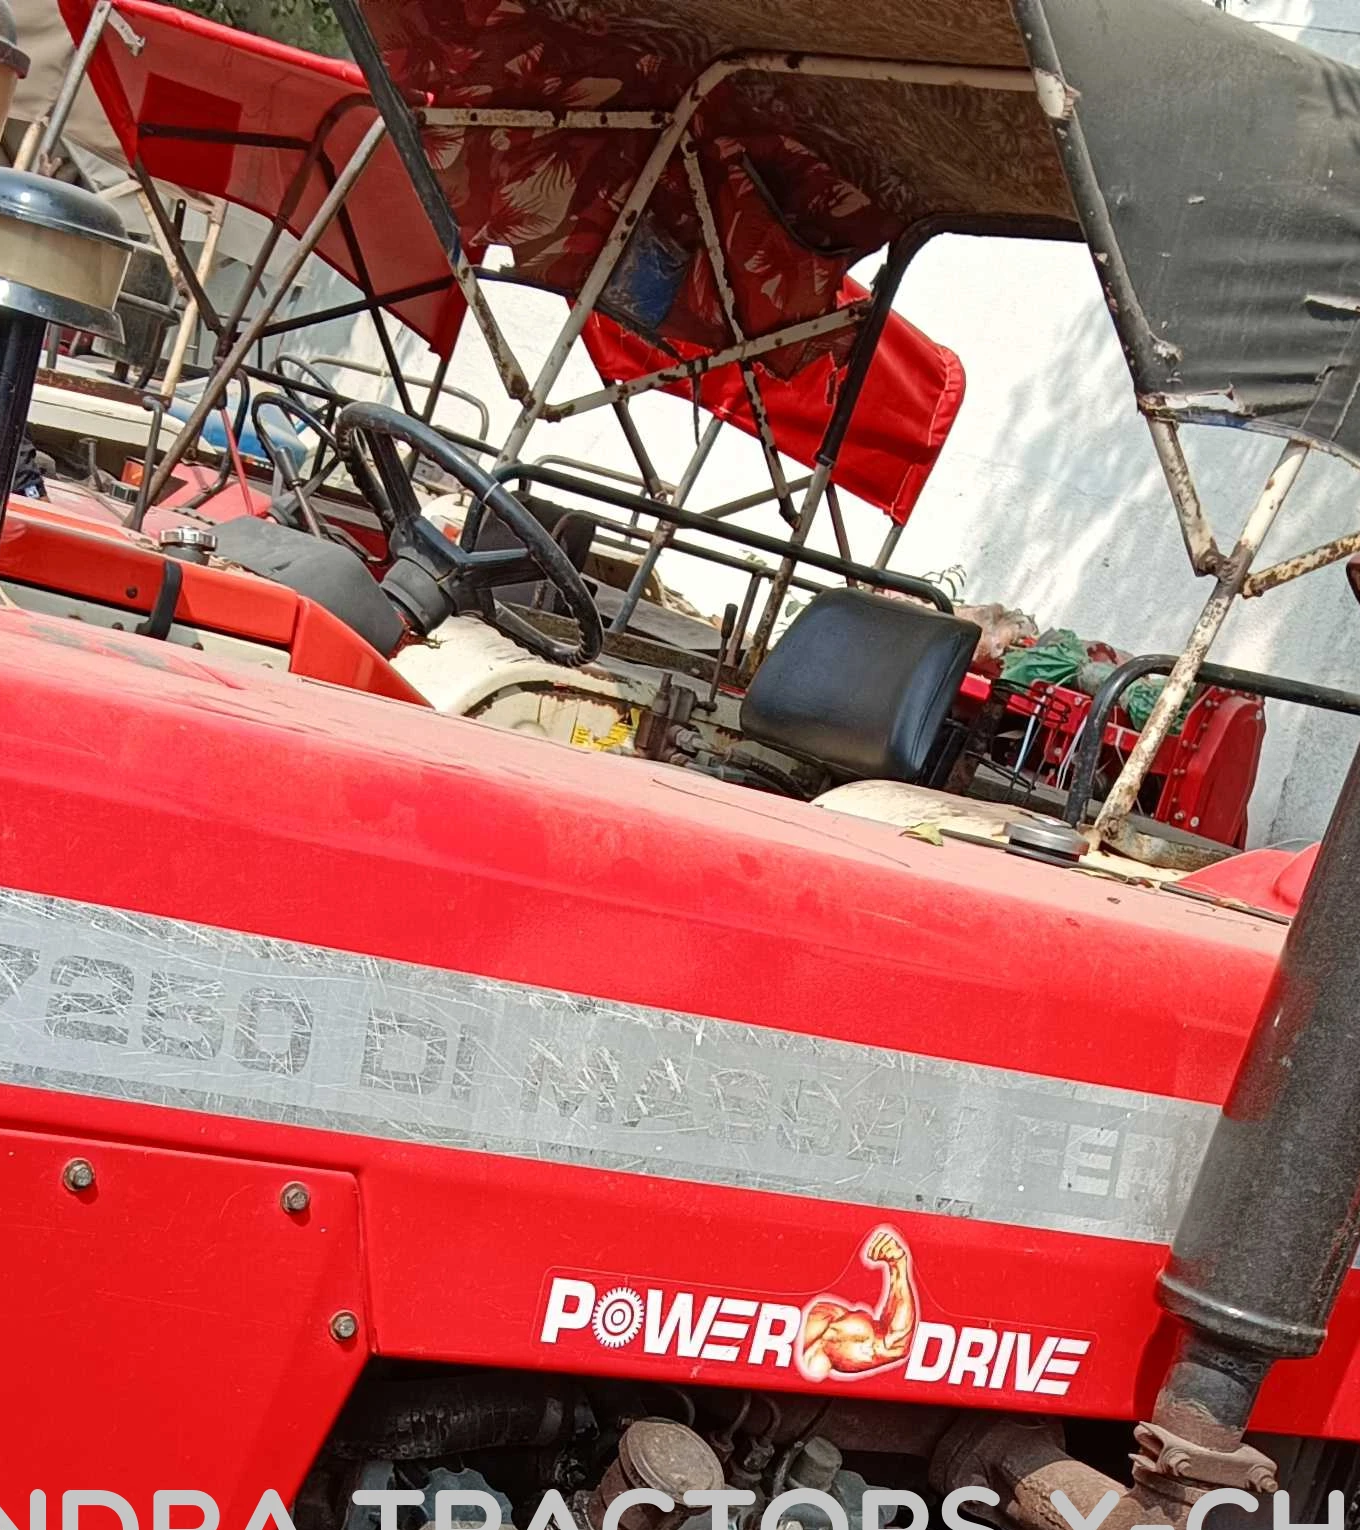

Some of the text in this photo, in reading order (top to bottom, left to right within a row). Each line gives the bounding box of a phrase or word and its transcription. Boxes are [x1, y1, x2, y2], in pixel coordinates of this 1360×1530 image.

[359, 1006, 479, 1102] DI
[540, 1276, 1092, 1397] POWER DRIVE
